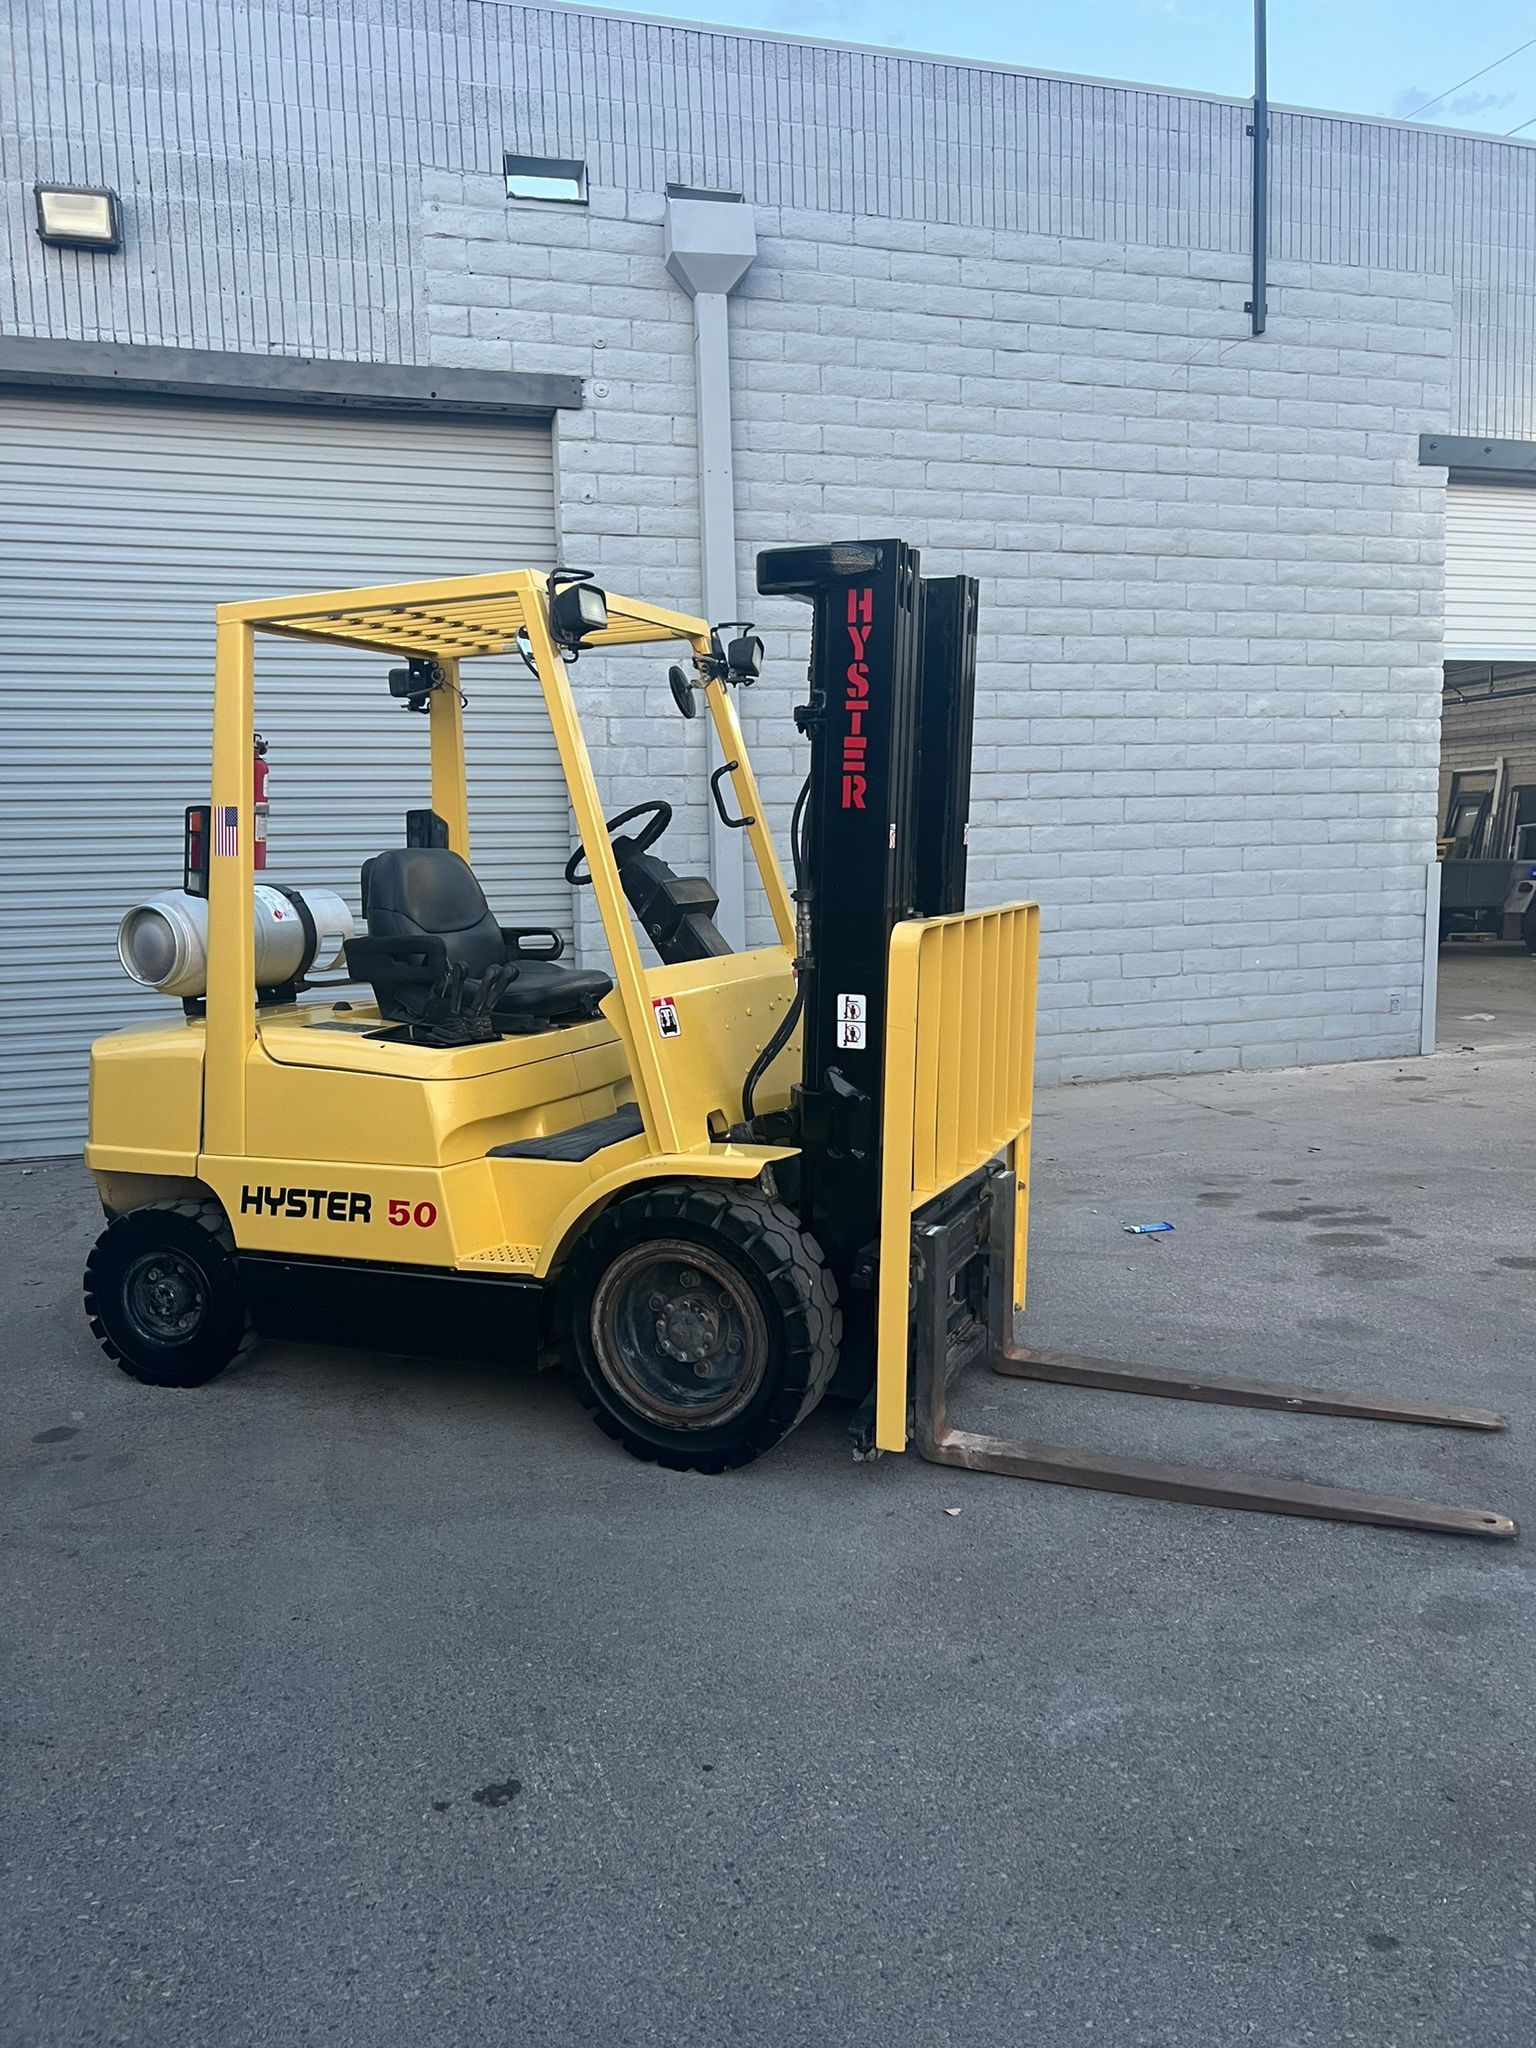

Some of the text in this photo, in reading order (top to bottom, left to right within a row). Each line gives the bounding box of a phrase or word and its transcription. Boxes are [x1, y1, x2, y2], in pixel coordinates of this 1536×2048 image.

[842, 588, 873, 809] HYSTER
[240, 1185, 437, 1228] HYSTER 50
